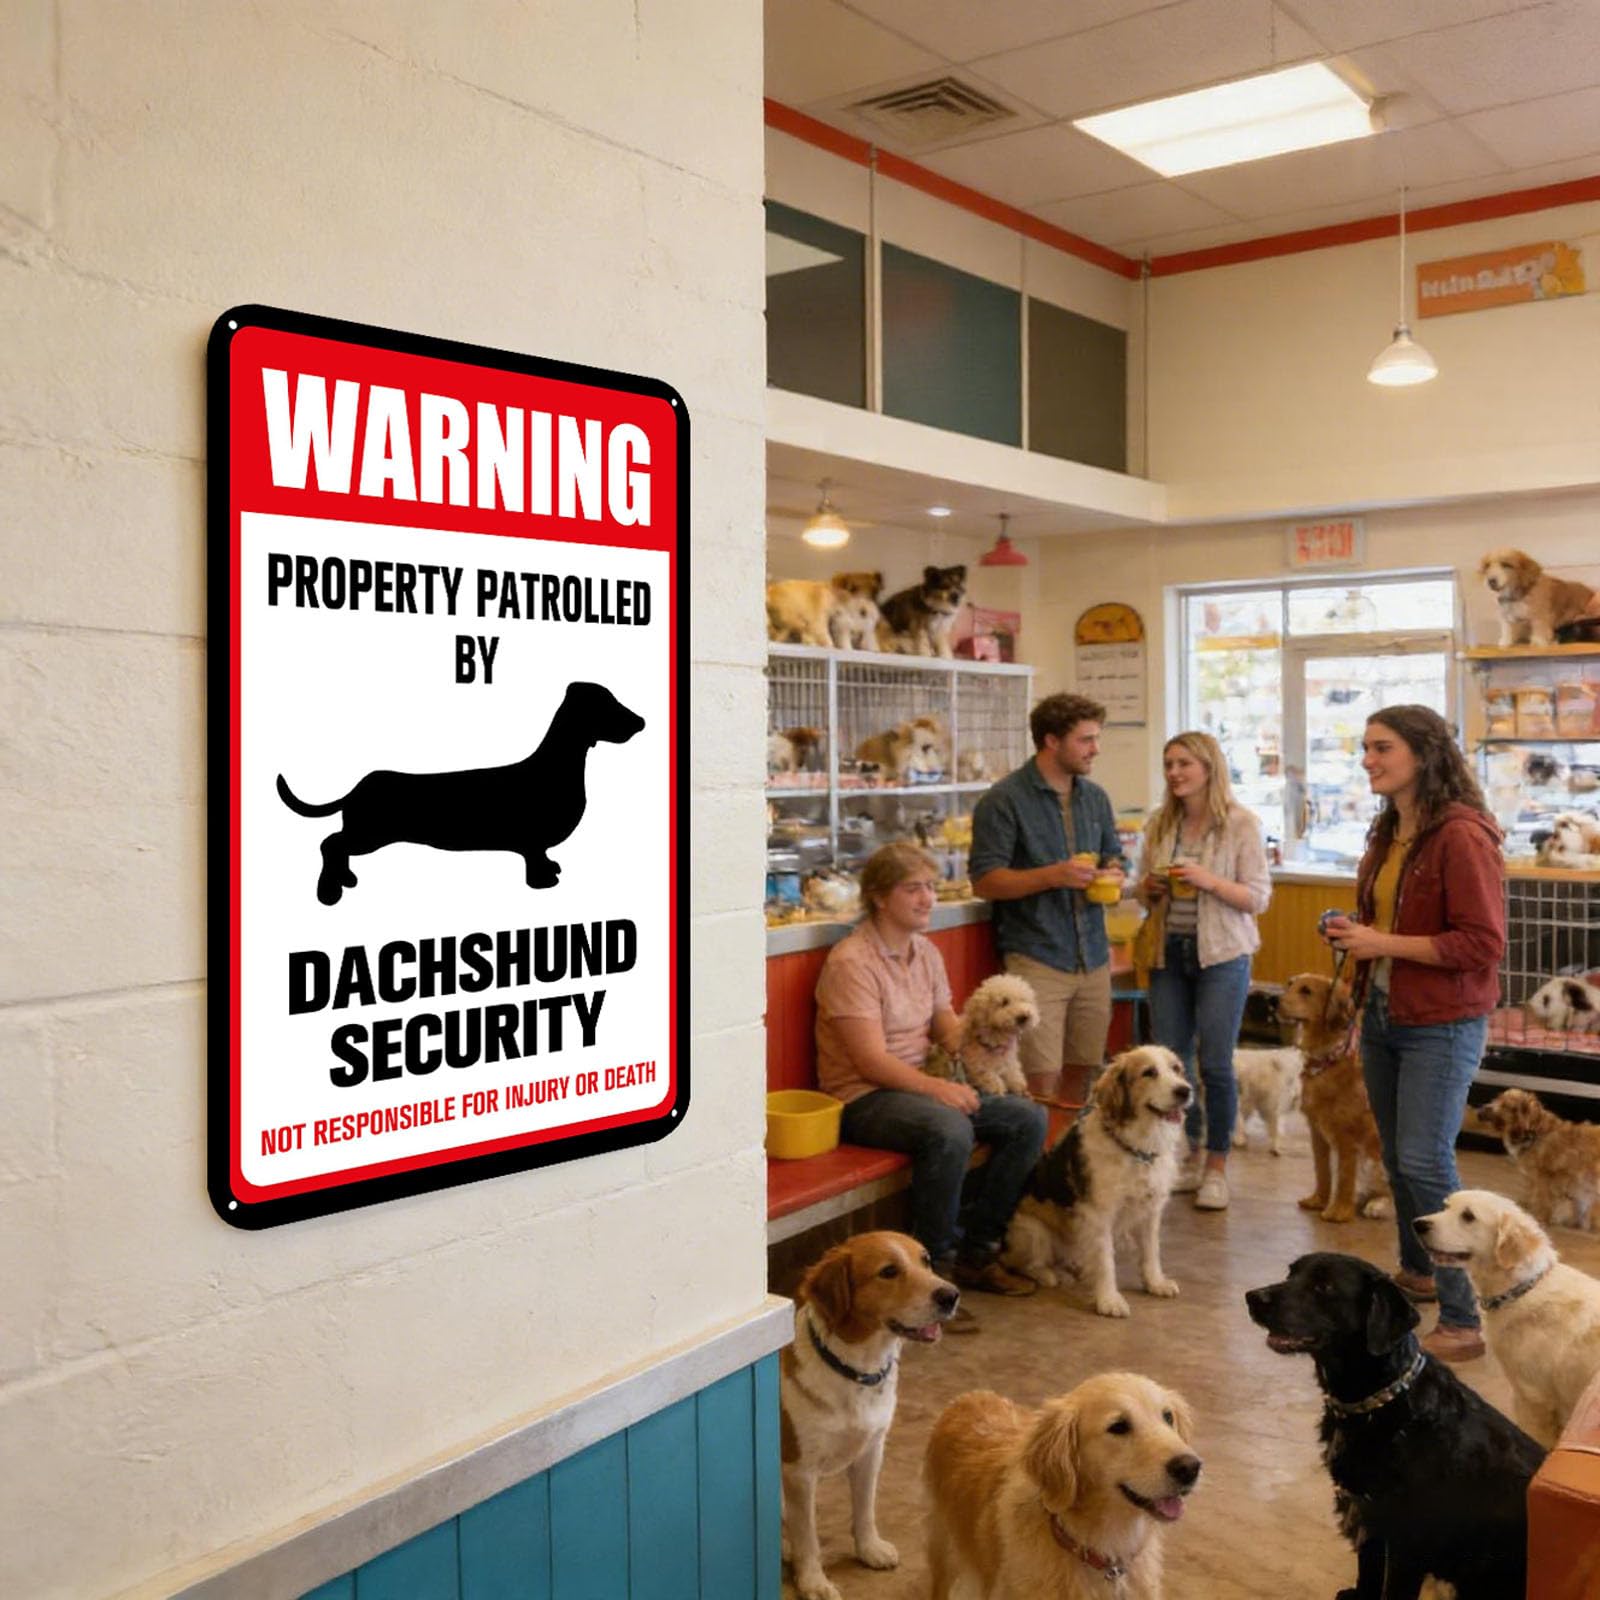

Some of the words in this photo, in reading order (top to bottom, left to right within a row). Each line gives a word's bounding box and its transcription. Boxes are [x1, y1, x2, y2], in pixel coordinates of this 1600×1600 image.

[262, 368, 651, 527] WARNING
[268, 553, 464, 616] PROPERTY
[478, 569, 651, 626] PATROLLED
[455, 635, 500, 685] BY
[289, 919, 637, 1016] DACHSHUND
[329, 990, 606, 1088] SECURITY
[261, 1123, 307, 1157] NOT
[314, 1097, 456, 1147] RESPONSIBLE
[462, 1089, 499, 1119] FOR
[505, 1076, 570, 1110] INJURY
[576, 1071, 599, 1097] OR
[604, 1061, 656, 1091] DEATH
